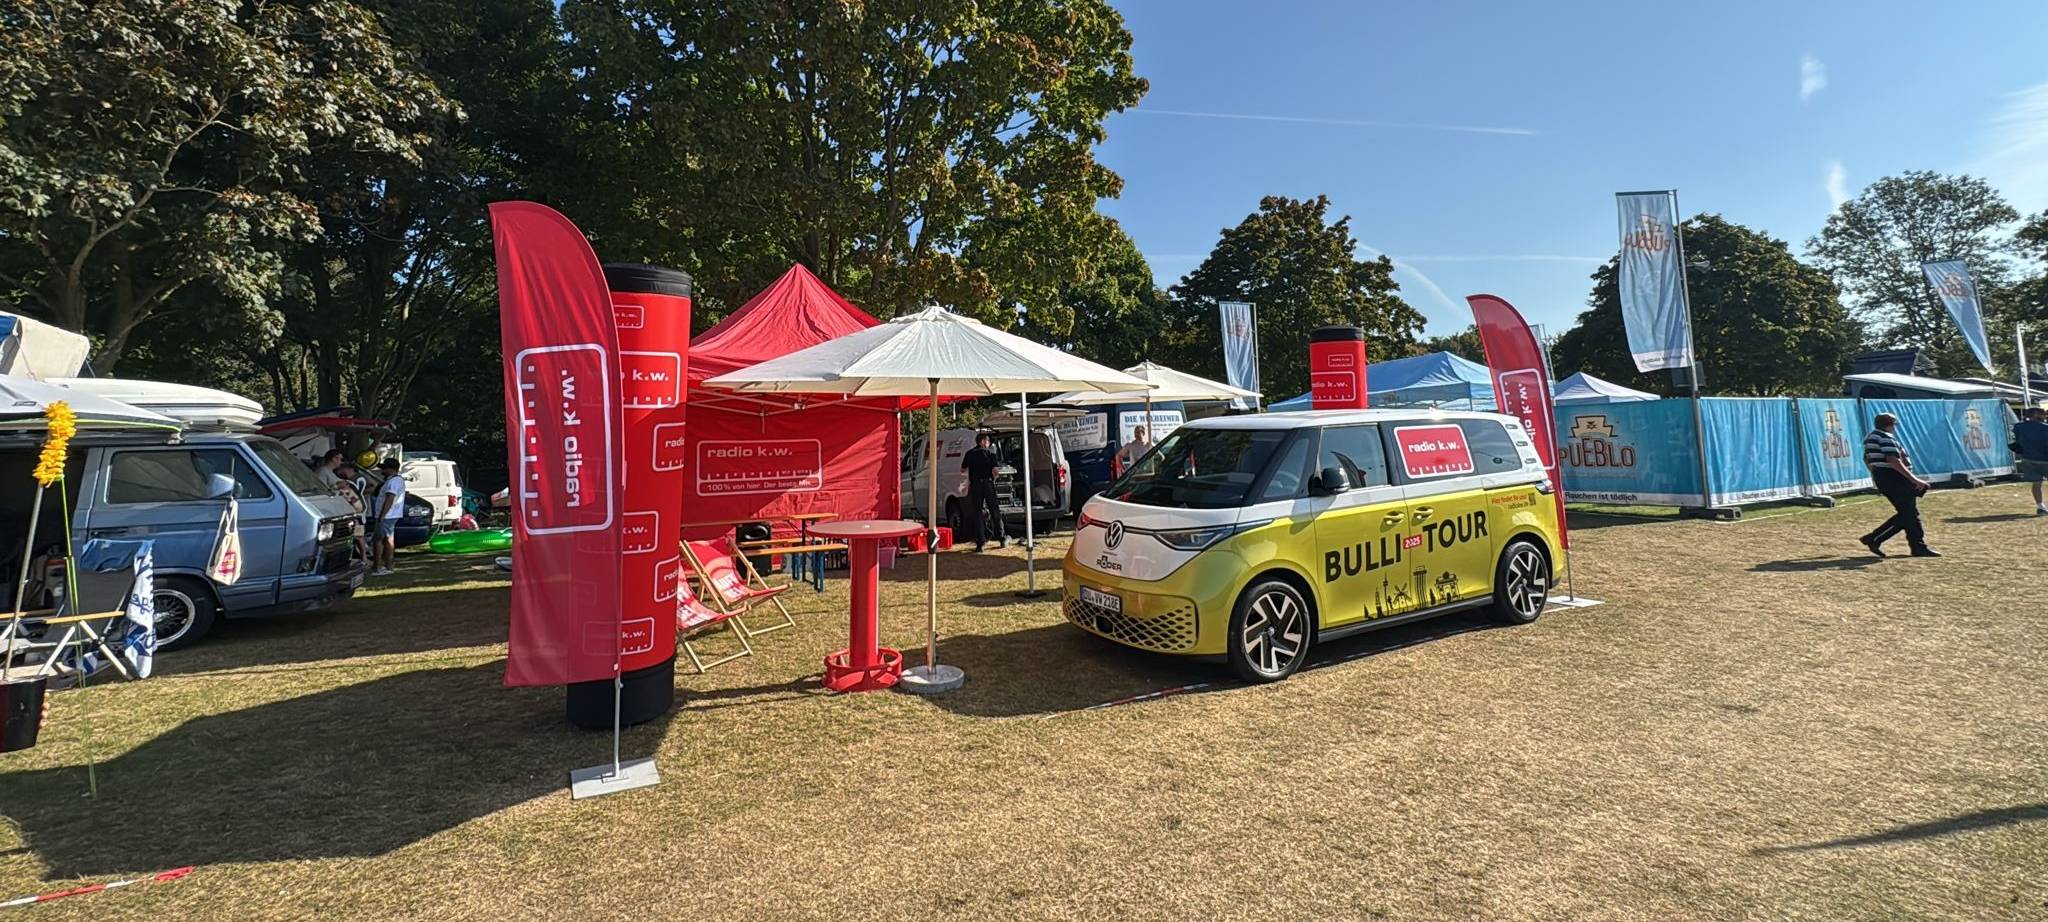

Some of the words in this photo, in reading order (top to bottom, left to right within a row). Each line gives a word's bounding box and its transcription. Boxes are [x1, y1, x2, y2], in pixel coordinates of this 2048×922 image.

[632, 369, 669, 381] k.w.
[707, 446, 753, 458] radio
[757, 446, 793, 457] k.w.
[1408, 440, 1436, 453] radio
[1437, 440, 1460, 451] k.w.
[1559, 438, 1635, 468] PUEBLO
[764, 481, 777, 489] Der
[1565, 491, 1597, 500] Rauchen
[1325, 533, 1401, 583] BULLI
[1405, 537, 1420, 548] 2025
[1422, 510, 1488, 552] TOUR
[622, 630, 646, 638] k.w.
